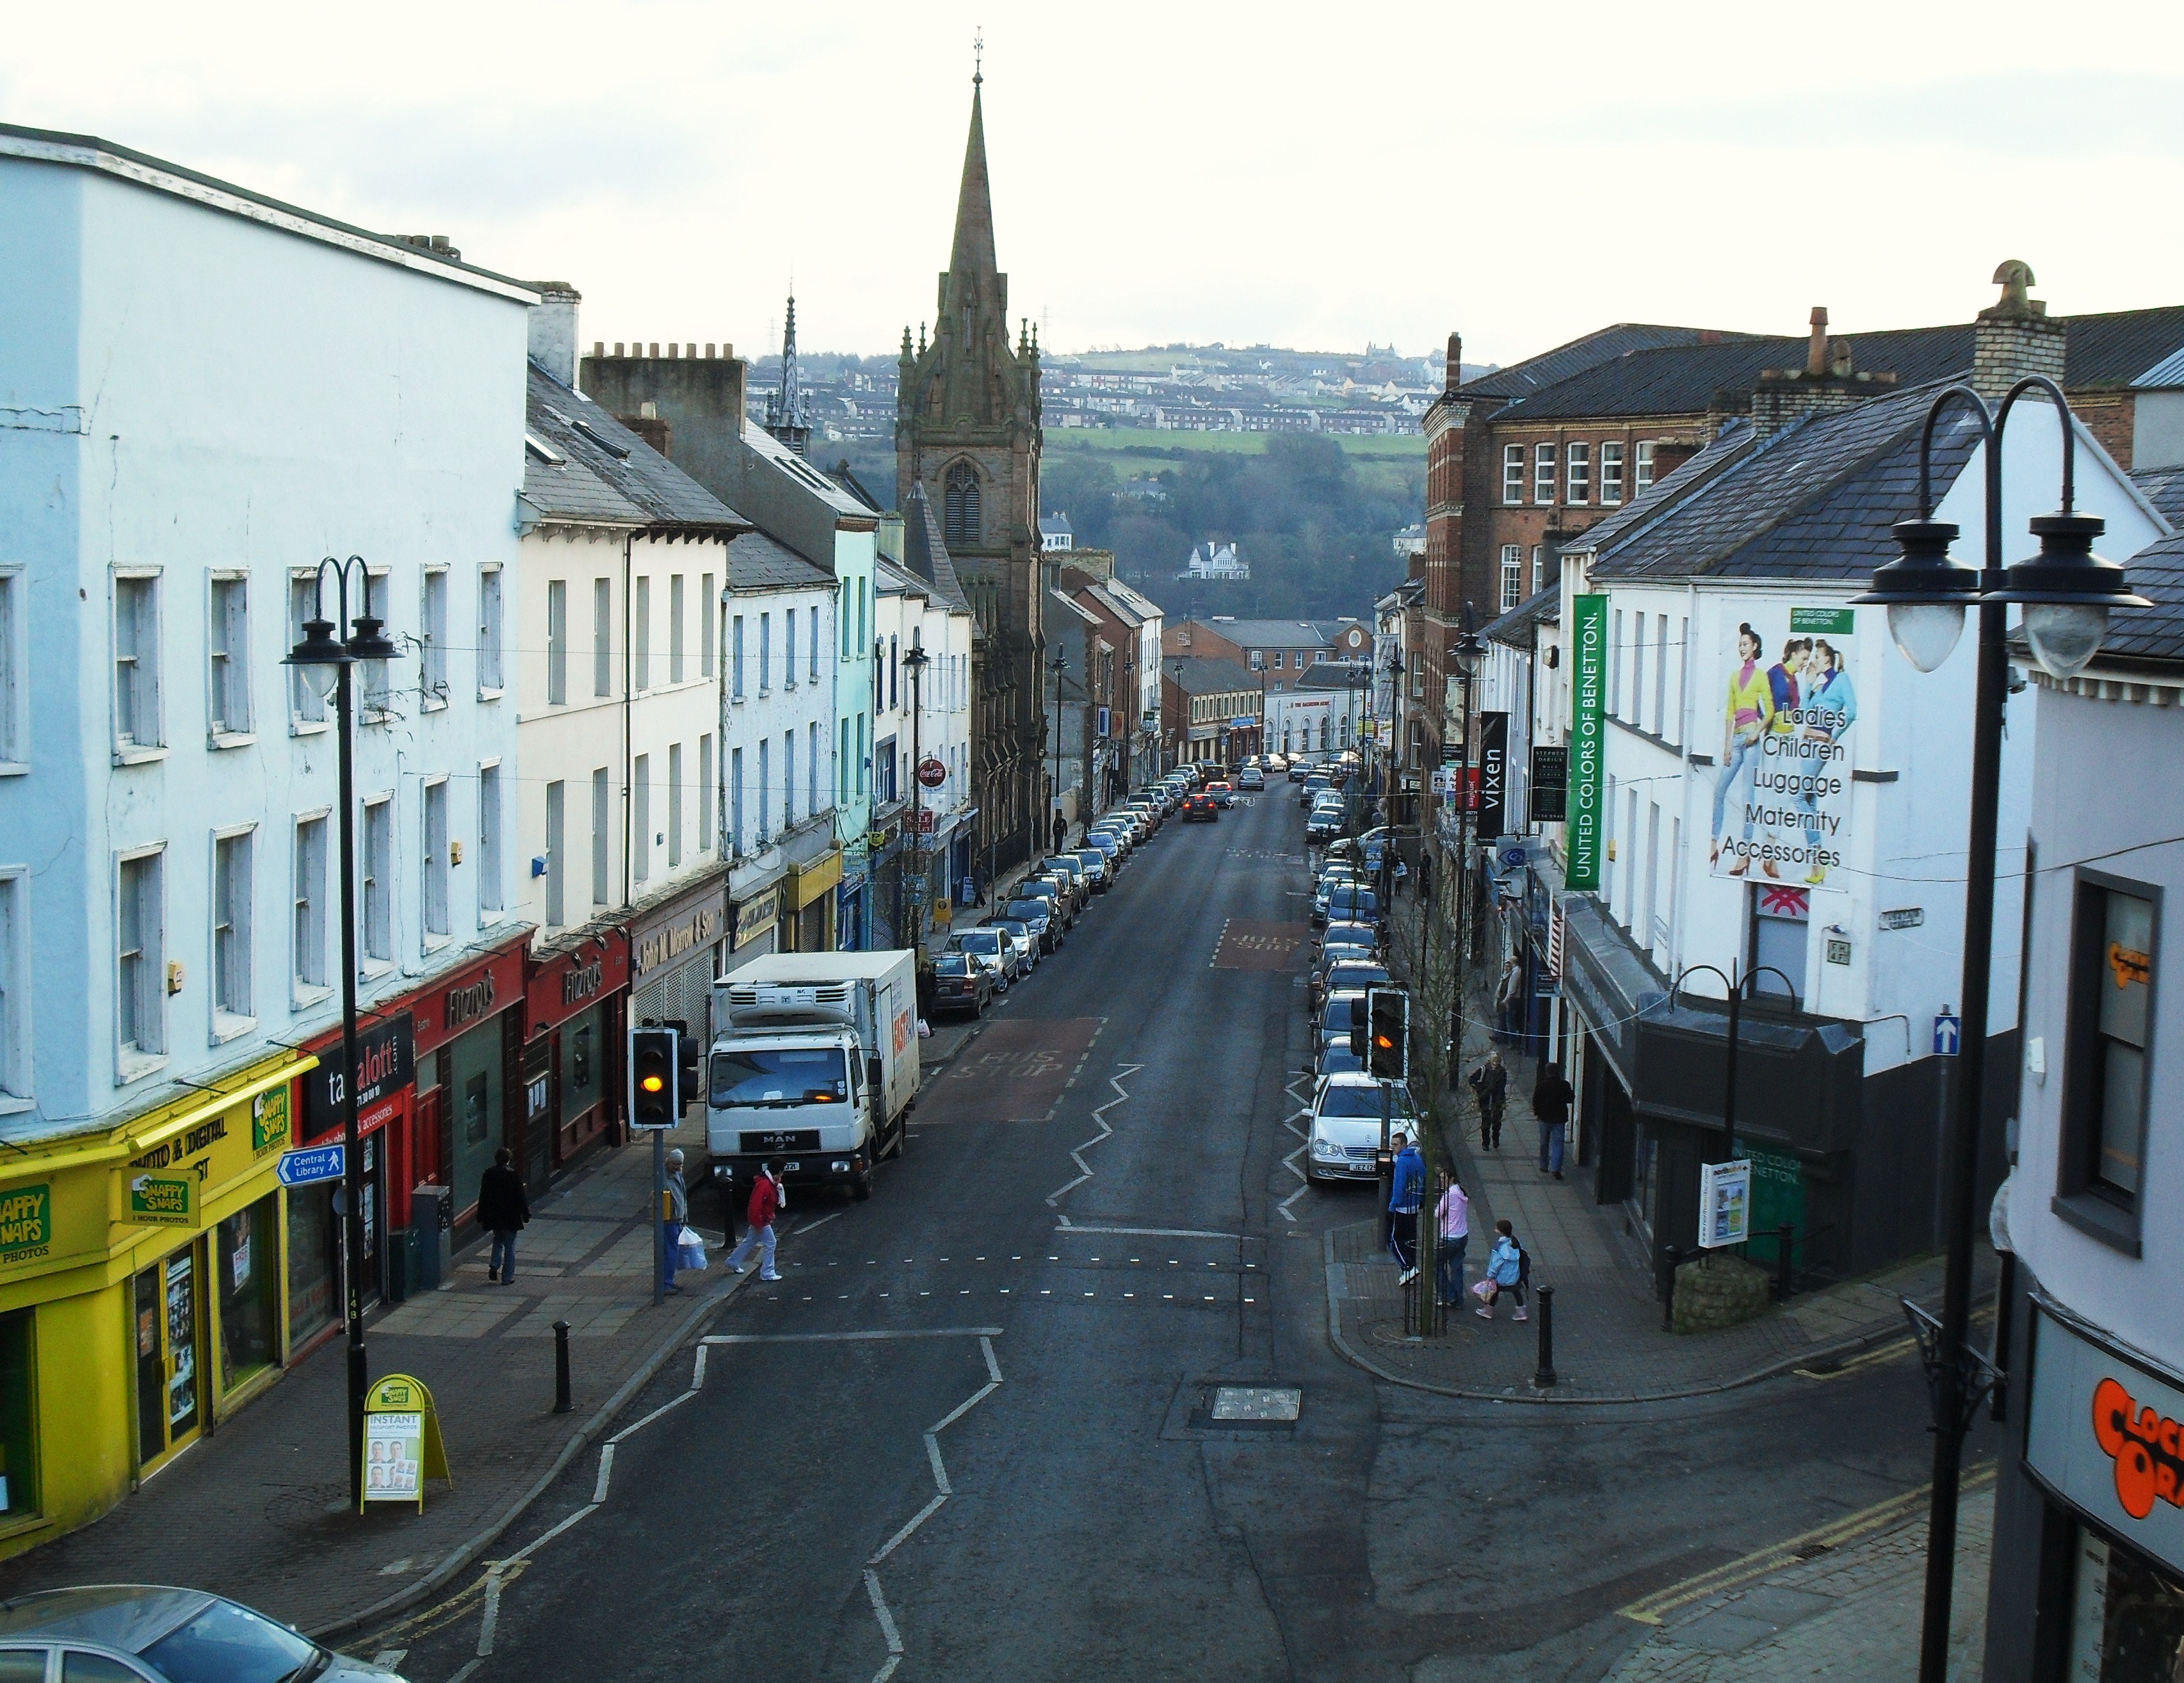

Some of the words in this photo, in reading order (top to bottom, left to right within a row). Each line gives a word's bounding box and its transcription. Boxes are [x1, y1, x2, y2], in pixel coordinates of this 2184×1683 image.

[1581, 714, 1596, 736] OF
[1783, 703, 1845, 729] Ladies
[1763, 736, 1844, 761] Children
[1485, 749, 1501, 809] vixen
[1579, 741, 1595, 809] COLORS
[1753, 767, 1841, 798] Luggage
[1745, 804, 1841, 836] Maternity
[1576, 814, 1592, 878] UNITED
[1722, 836, 1841, 868] Accessories
[640, 941, 659, 975] John
[693, 915, 700, 943] &
[701, 910, 714, 939] Son
[979, 1051, 1062, 1064] BUS
[951, 1063, 1063, 1078] STOP
[263, 1114, 284, 1142] SNAPS
[363, 1103, 393, 1131] accessories
[173, 1138, 184, 1162] &
[186, 1116, 228, 1153] DIGITAL
[294, 1154, 325, 1166] Central
[296, 1164, 325, 1177] Library
[139, 1180, 184, 1199] SNAPPY
[145, 1197, 183, 1211] SNAPS
[159, 1216, 189, 1224] PHOTOS
[3, 1246, 49, 1264] PHOTOS
[371, 1415, 417, 1424] INSTANT
